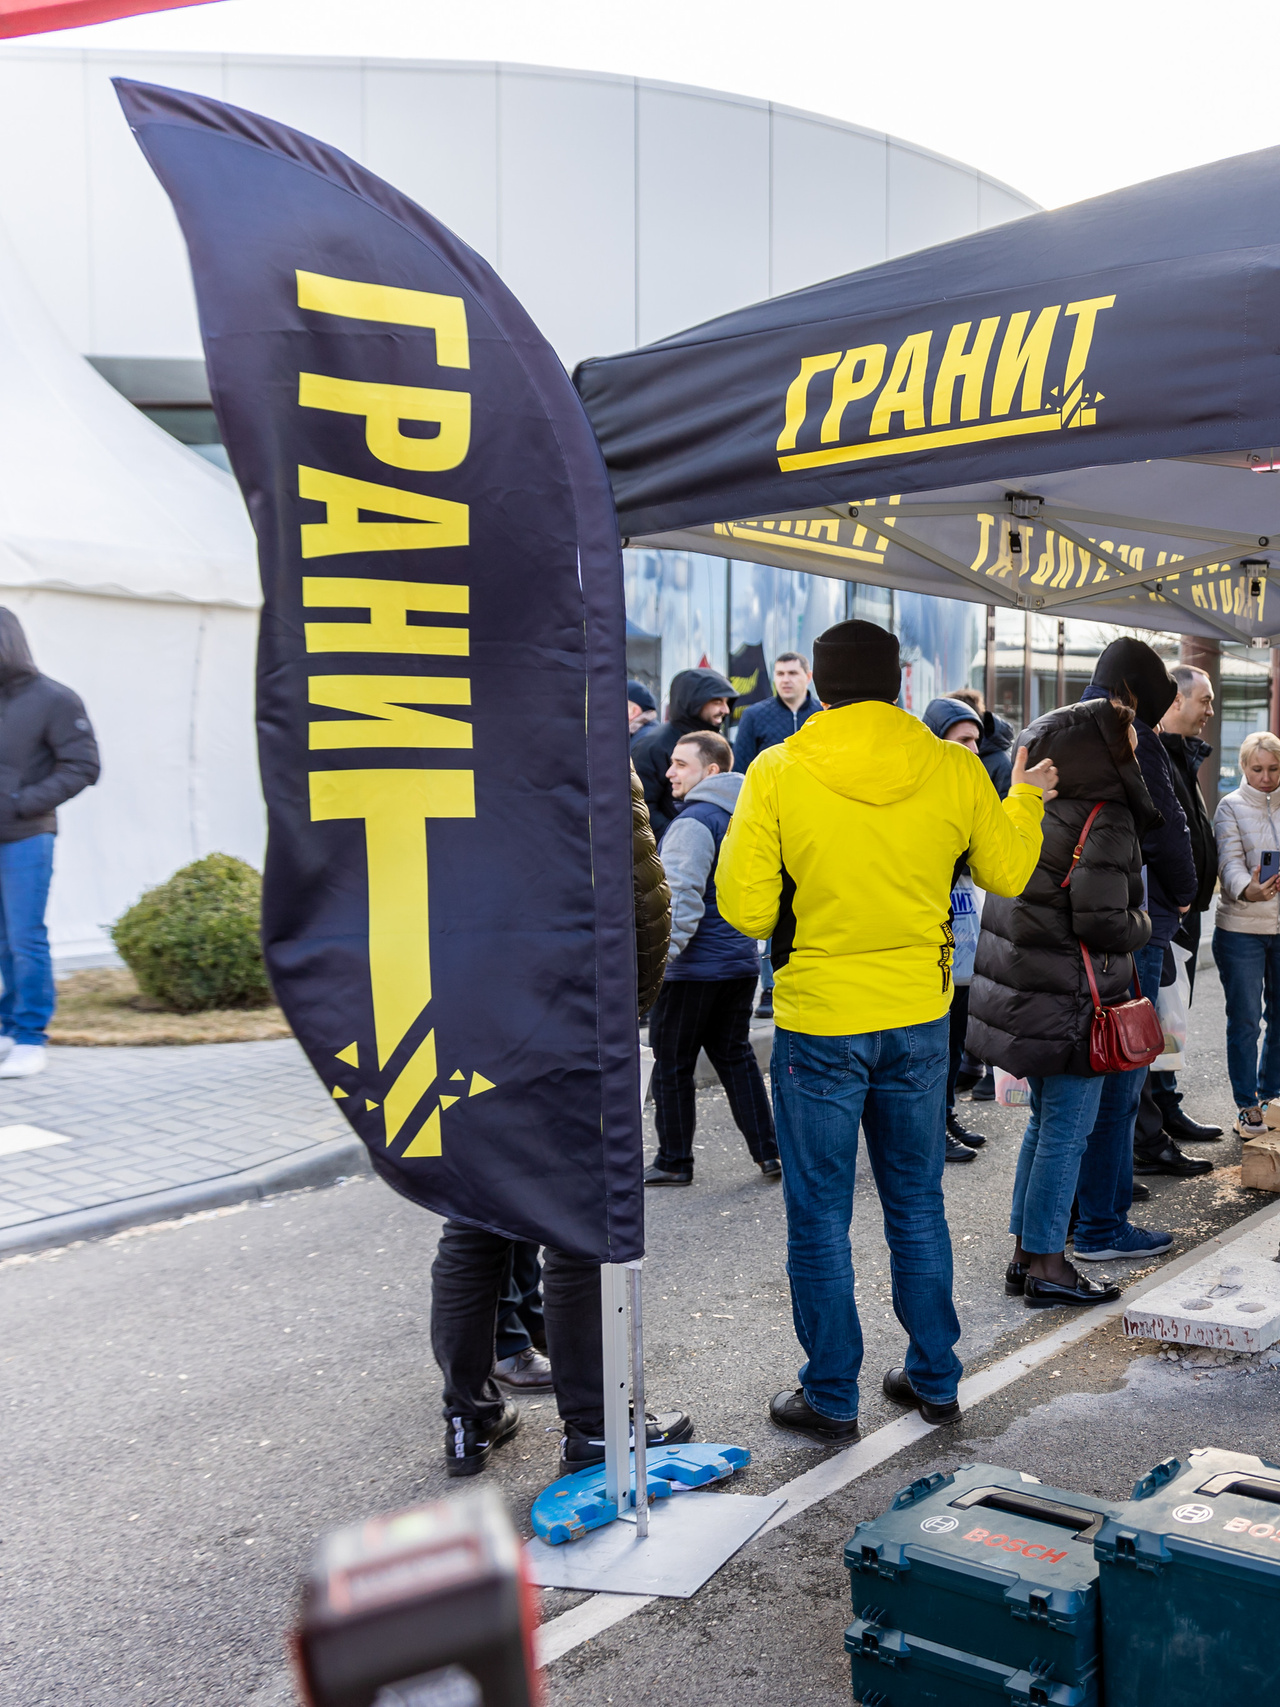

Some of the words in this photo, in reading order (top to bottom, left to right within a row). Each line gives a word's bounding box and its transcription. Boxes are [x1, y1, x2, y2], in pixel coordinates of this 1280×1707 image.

[776, 294, 1116, 451] ГРАНИТ
[296, 269, 476, 1158] ГРАНИТ
[962, 1527, 1068, 1564] BOSCH
